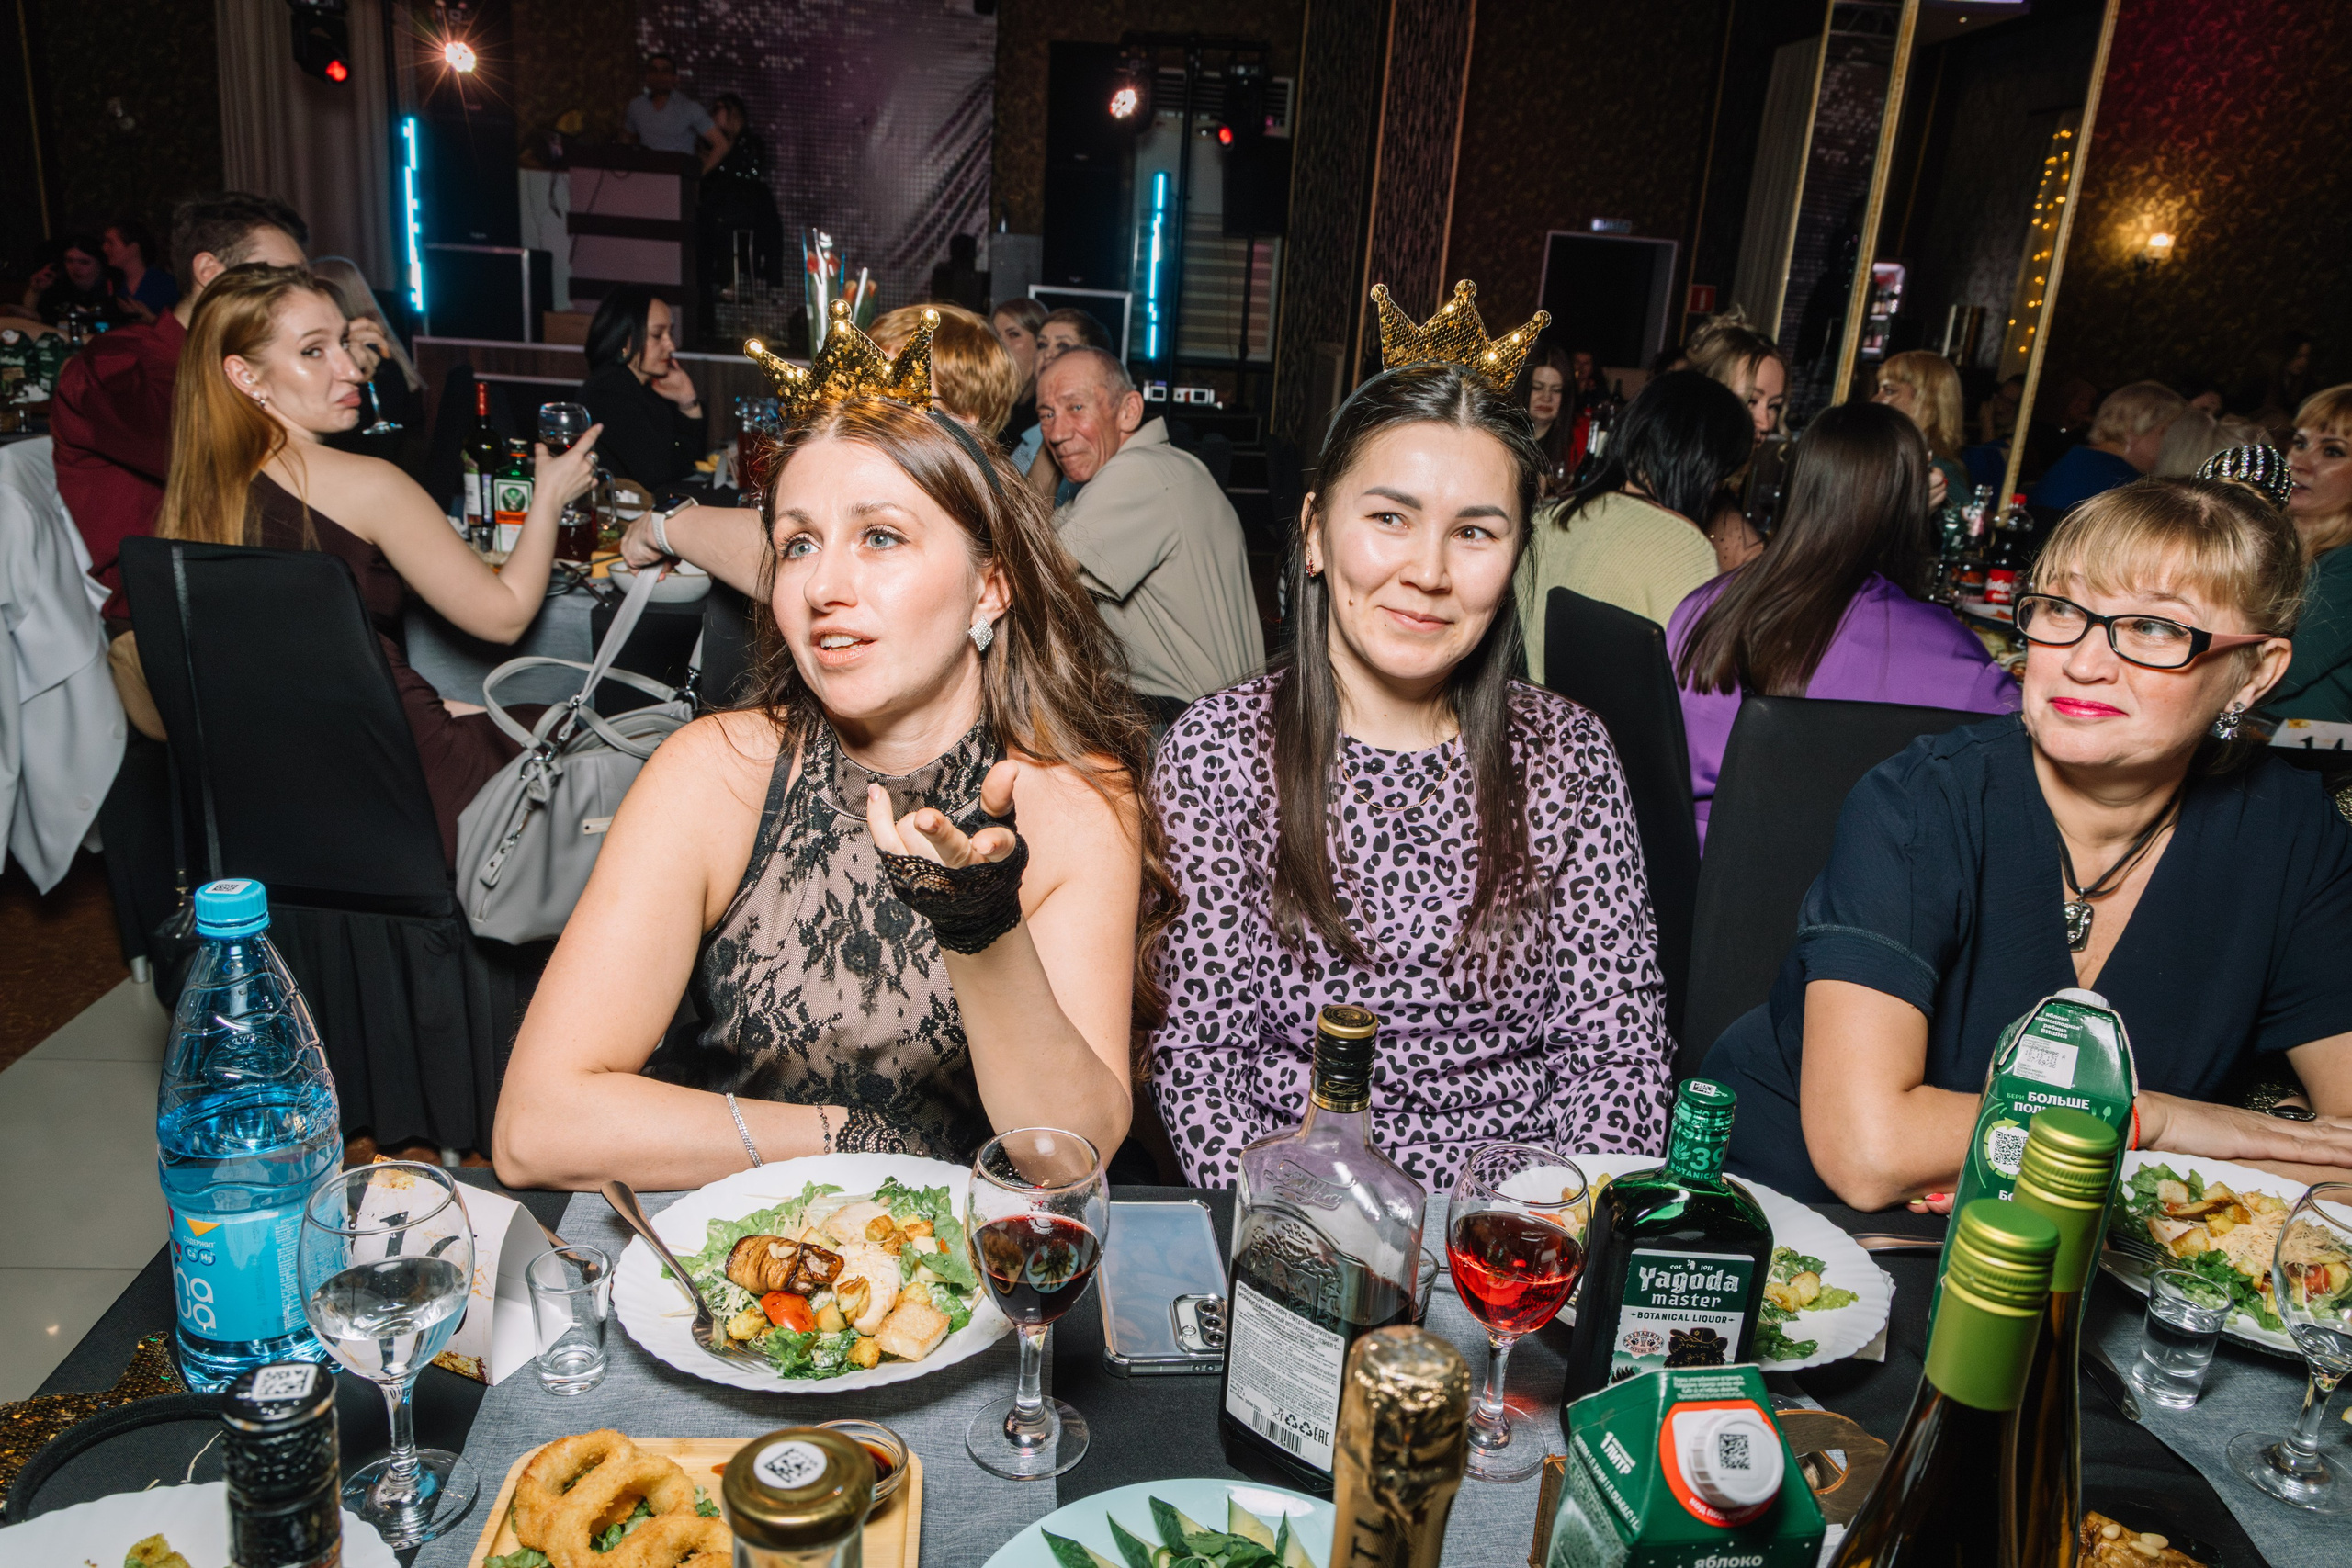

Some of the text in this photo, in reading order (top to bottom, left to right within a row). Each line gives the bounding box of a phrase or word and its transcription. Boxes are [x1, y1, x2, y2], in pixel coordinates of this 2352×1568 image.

[2014, 1102, 2047, 1114] ПОЛ
[2028, 1091, 2090, 1110] БОЛЬШЕ
[1639, 1266, 1740, 1294] Yagoda
[1651, 1292, 1722, 1308] master
[1637, 1312, 1727, 1324] BOTANICAL LIQUOR
[1604, 1444, 1632, 1474] ЛИТР
[1694, 1555, 1763, 1568] яблоко
